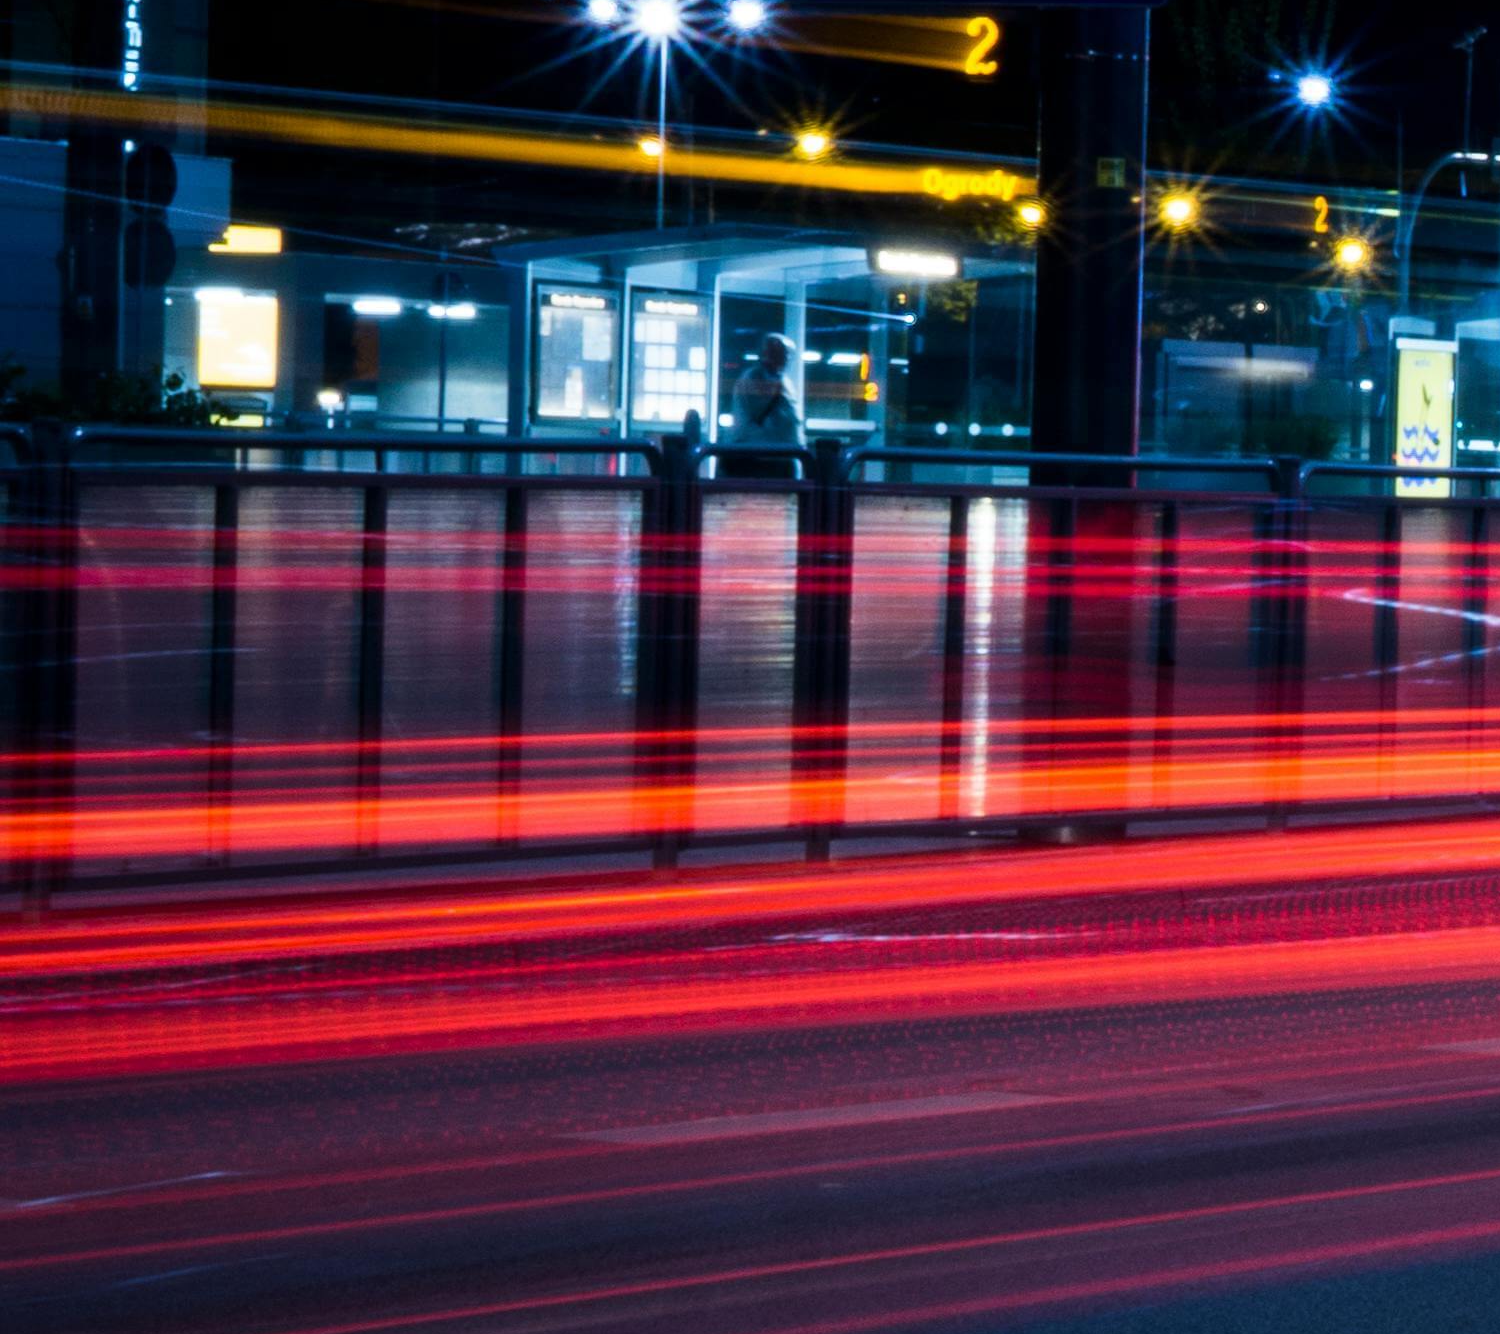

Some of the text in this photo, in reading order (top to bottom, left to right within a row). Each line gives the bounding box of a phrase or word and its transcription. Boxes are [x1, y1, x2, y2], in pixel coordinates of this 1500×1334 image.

[965, 17, 999, 75] 2
[923, 167, 1018, 201] Ogrody
[1314, 195, 1328, 233] 2
